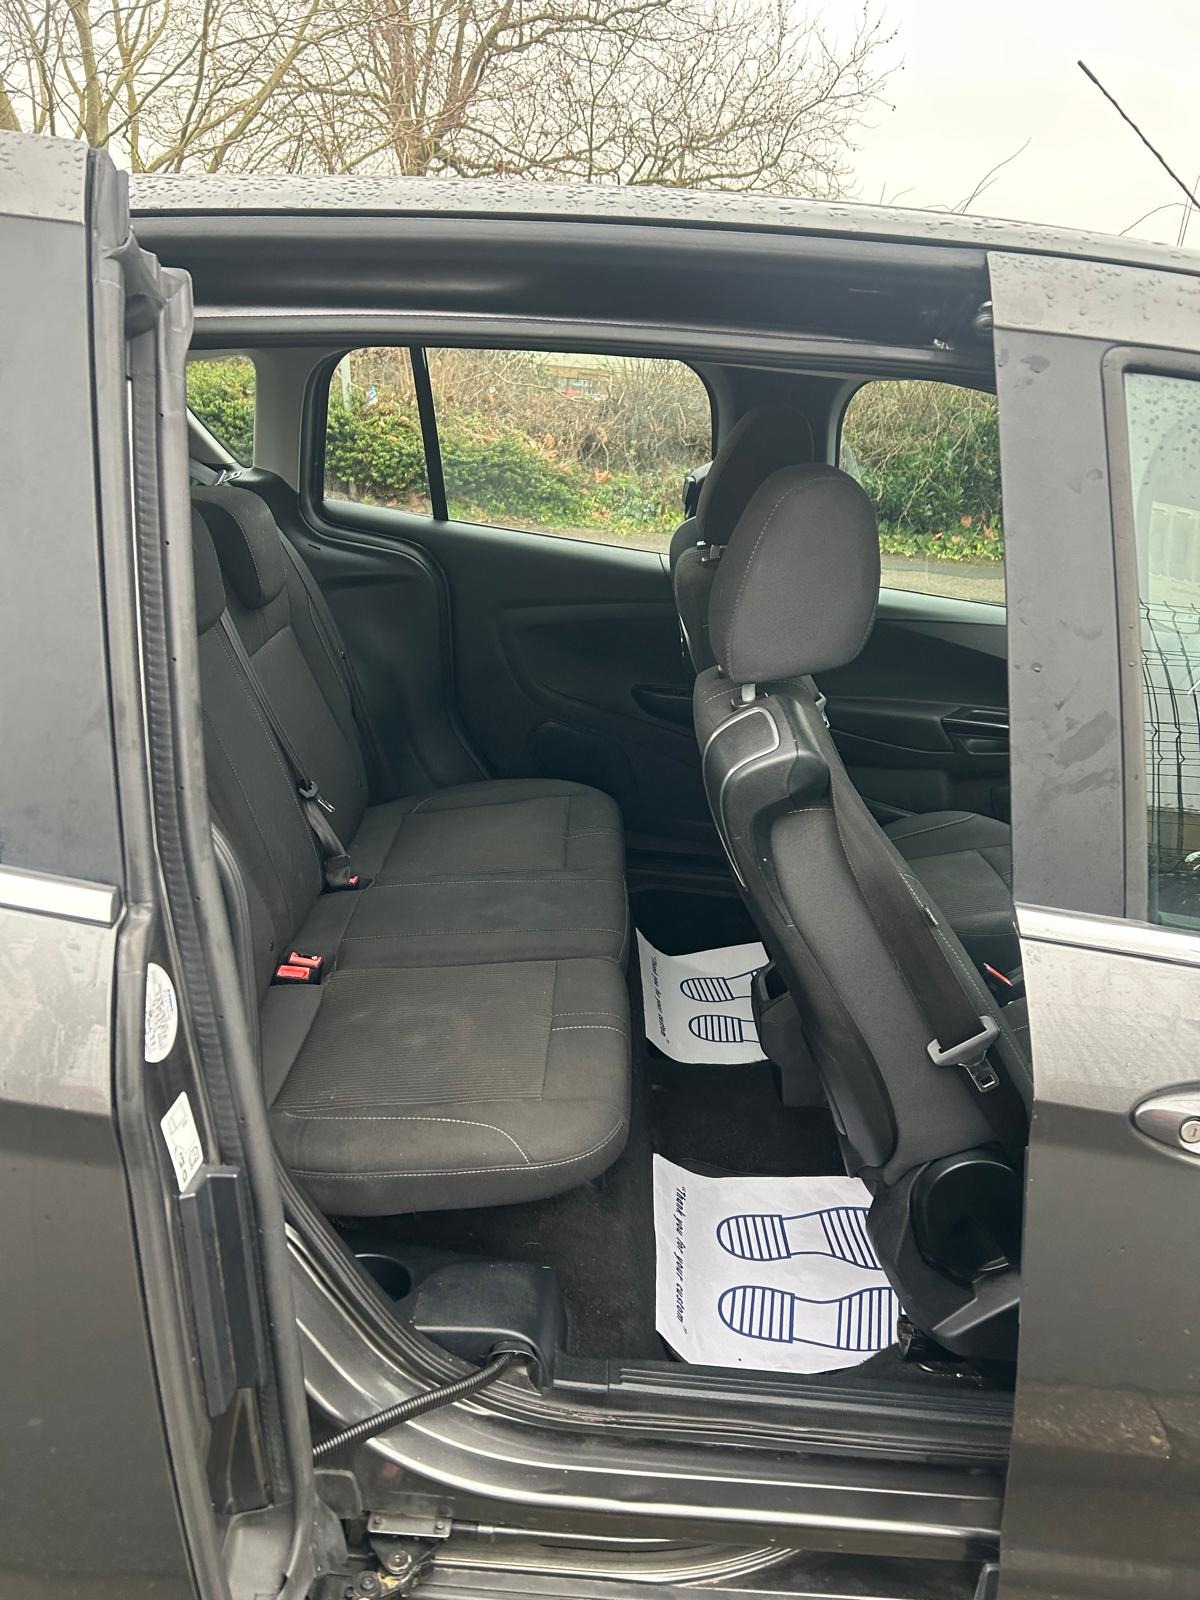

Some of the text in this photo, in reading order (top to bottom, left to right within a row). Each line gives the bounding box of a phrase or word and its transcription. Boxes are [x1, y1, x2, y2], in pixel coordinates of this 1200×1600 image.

[673, 1214, 684, 1236] you
[676, 1237, 686, 1254] for
[673, 1251, 684, 1282] your
[676, 1283, 686, 1323] custom
